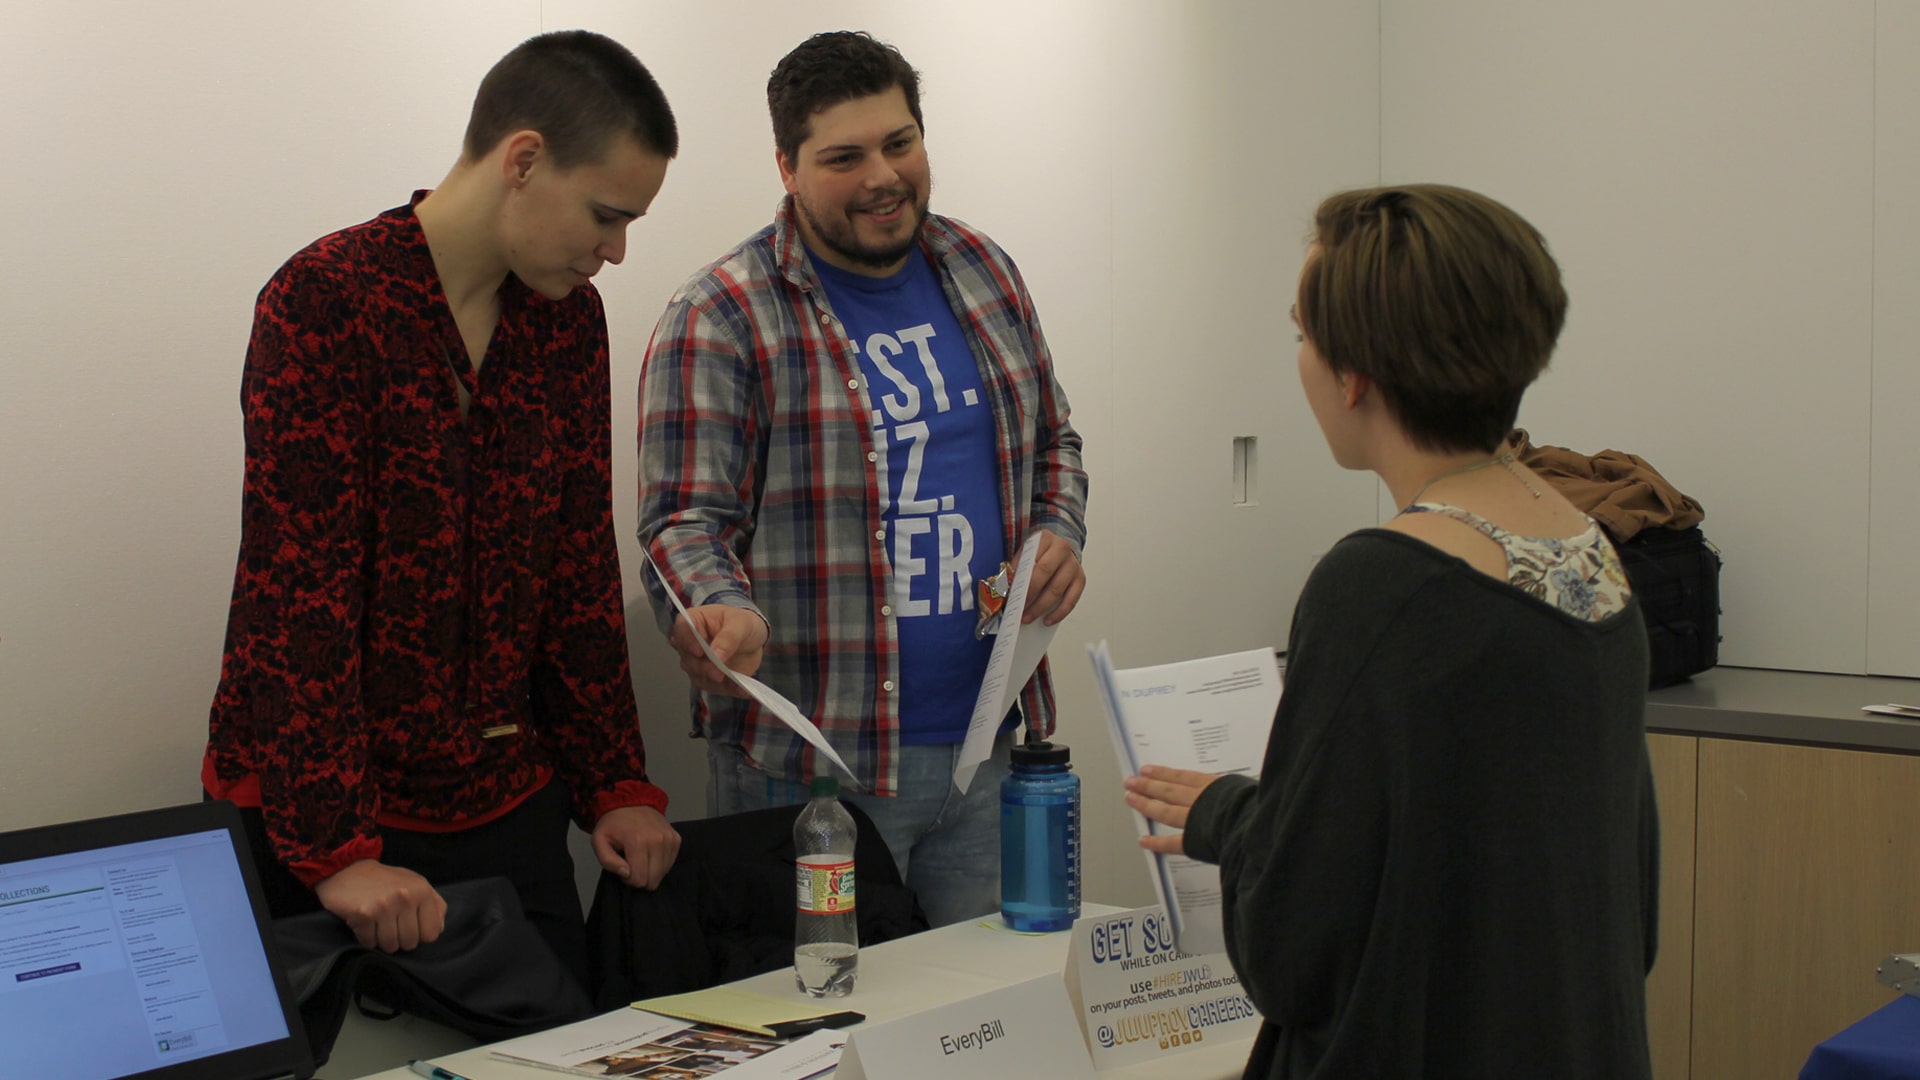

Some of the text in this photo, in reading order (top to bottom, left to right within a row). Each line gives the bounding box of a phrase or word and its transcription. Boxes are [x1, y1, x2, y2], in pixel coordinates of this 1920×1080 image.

[849, 322, 979, 425] ST.
[882, 514, 975, 618] ER
[0, 884, 50, 901] OLLECTIONS
[1091, 911, 1174, 963] GET SO
[1120, 956, 1151, 971] WHILE
[1152, 953, 1168, 966] ON
[1090, 1003, 1102, 1014] on
[1102, 999, 1122, 1013] your
[1123, 994, 1148, 1009] posts,
[1148, 989, 1177, 1003] tweets,
[1178, 984, 1194, 997] and
[1194, 979, 1223, 996] photos
[1130, 979, 1153, 994] use
[940, 1019, 1005, 1056] EveryBill
